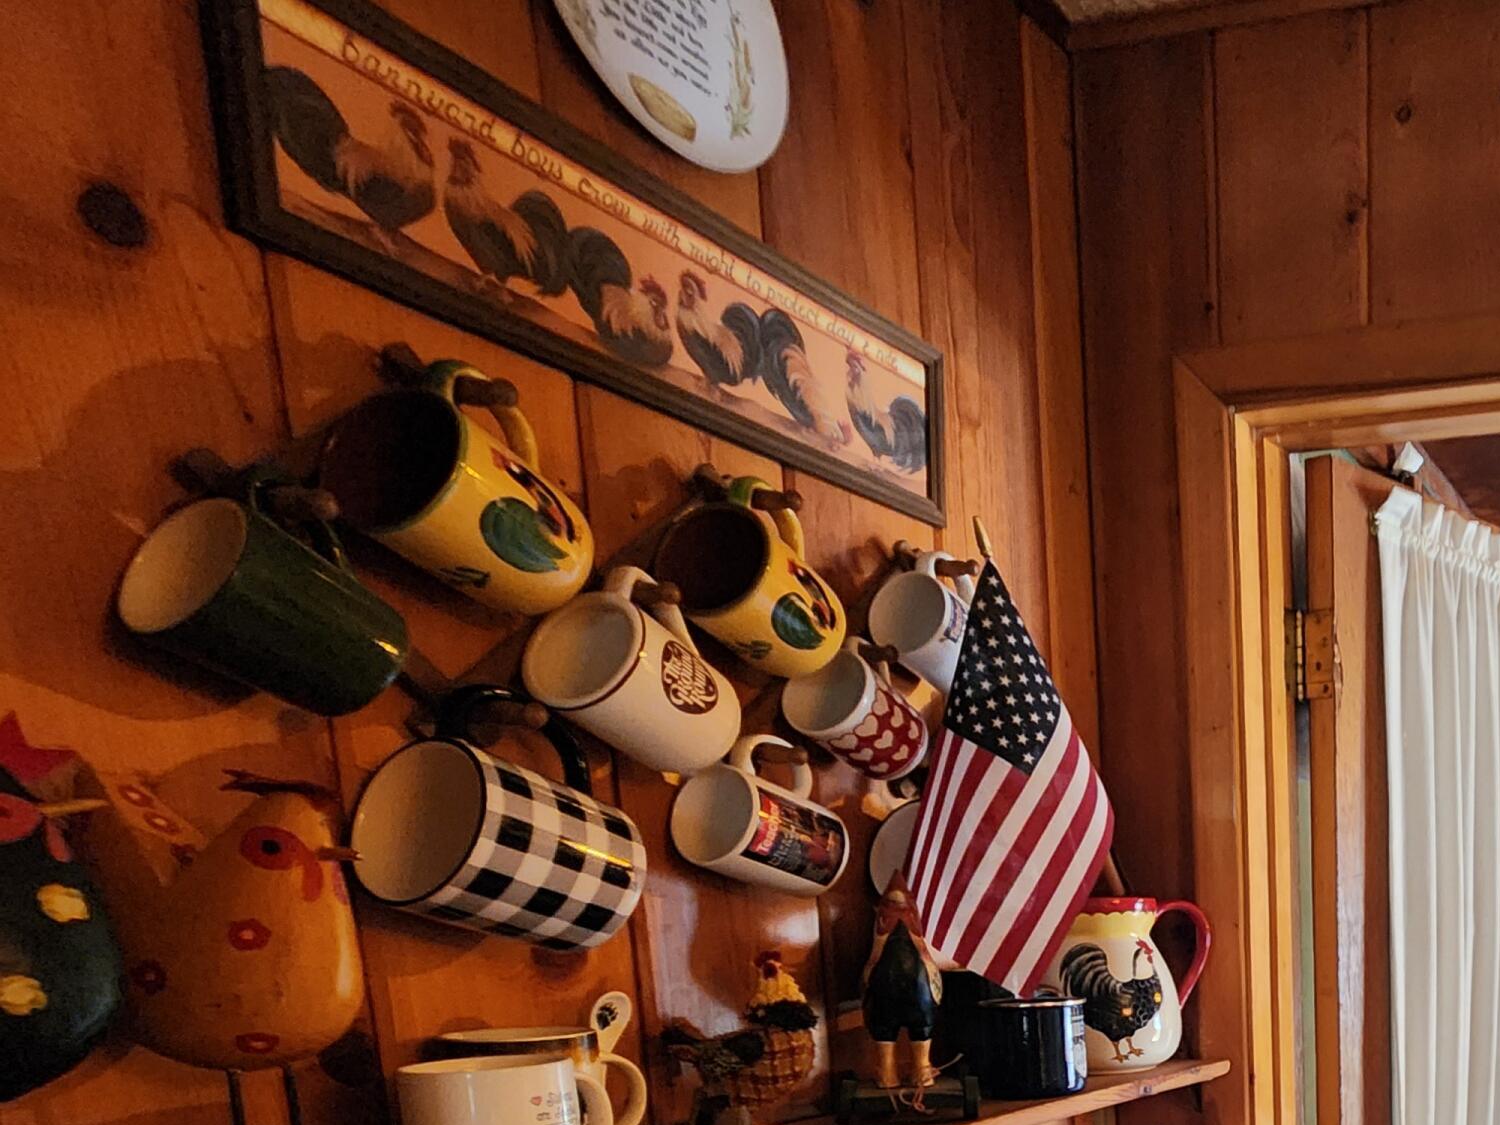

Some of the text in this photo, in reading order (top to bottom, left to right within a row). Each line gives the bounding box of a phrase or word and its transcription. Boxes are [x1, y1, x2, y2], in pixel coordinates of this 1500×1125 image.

[342, 32, 497, 143] barnyard
[510, 133, 563, 180] boys
[578, 177, 631, 219] crow
[642, 214, 680, 249] with
[746, 269, 761, 293] to
[766, 284, 820, 328] protect
[826, 314, 856, 348] day
